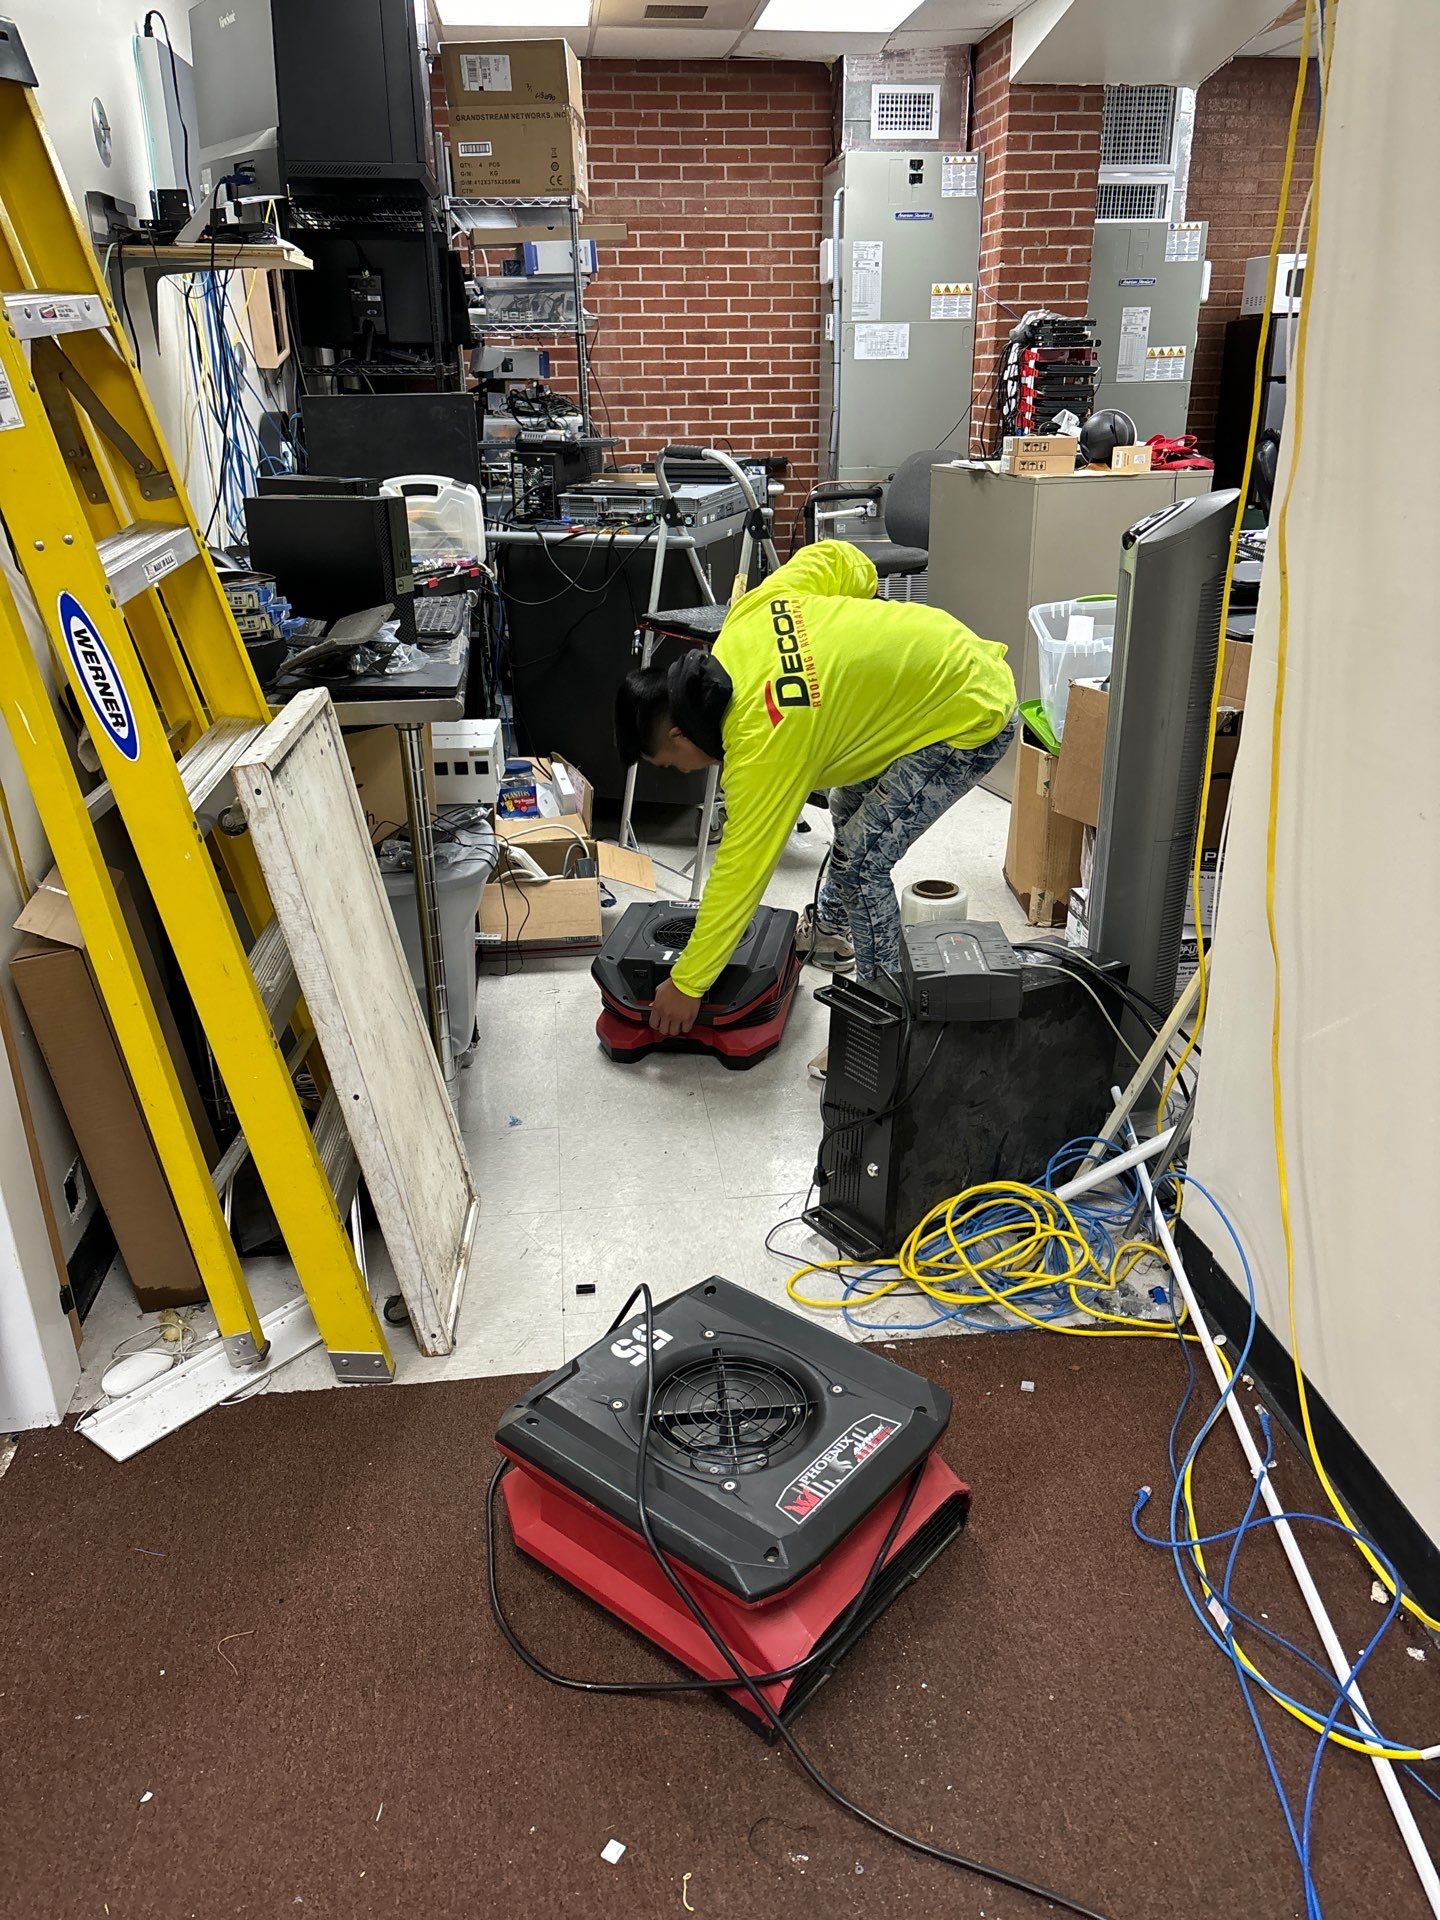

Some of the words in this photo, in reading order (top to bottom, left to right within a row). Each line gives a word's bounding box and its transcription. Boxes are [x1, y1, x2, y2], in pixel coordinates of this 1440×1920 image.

[456, 113, 509, 121] GRANDSTREAM
[73, 628, 126, 728] WERNER
[770, 599, 810, 707] DECOR
[803, 655, 822, 708] ROOFING
[798, 1435, 855, 1487] PHOENIX
